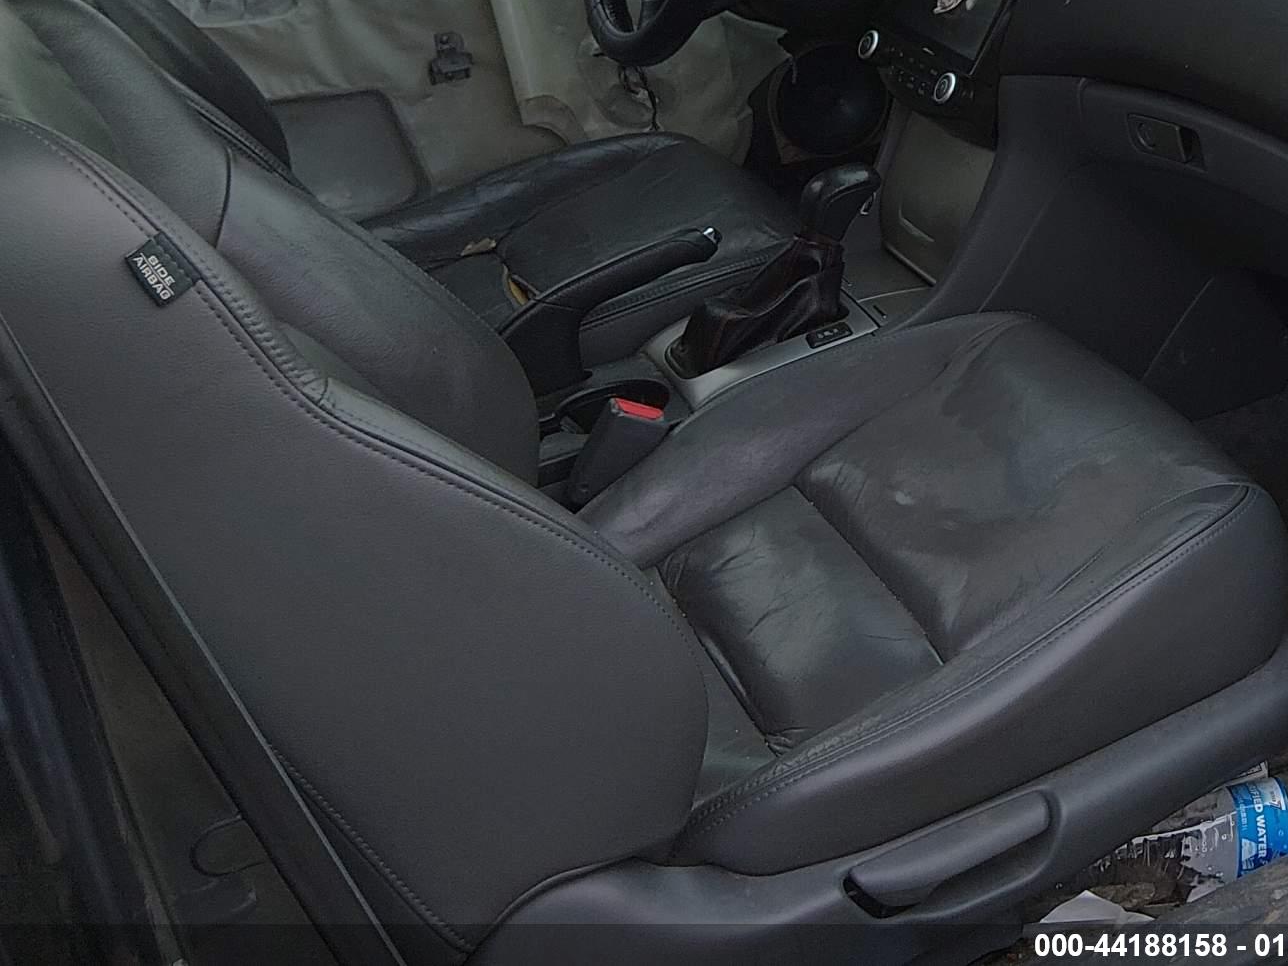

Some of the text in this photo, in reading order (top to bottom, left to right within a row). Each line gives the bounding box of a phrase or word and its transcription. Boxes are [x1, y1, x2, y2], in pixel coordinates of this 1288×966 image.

[132, 256, 172, 300] AIRBAG
[147, 255, 176, 286] SIDE
[1256, 814, 1267, 858] WATER
